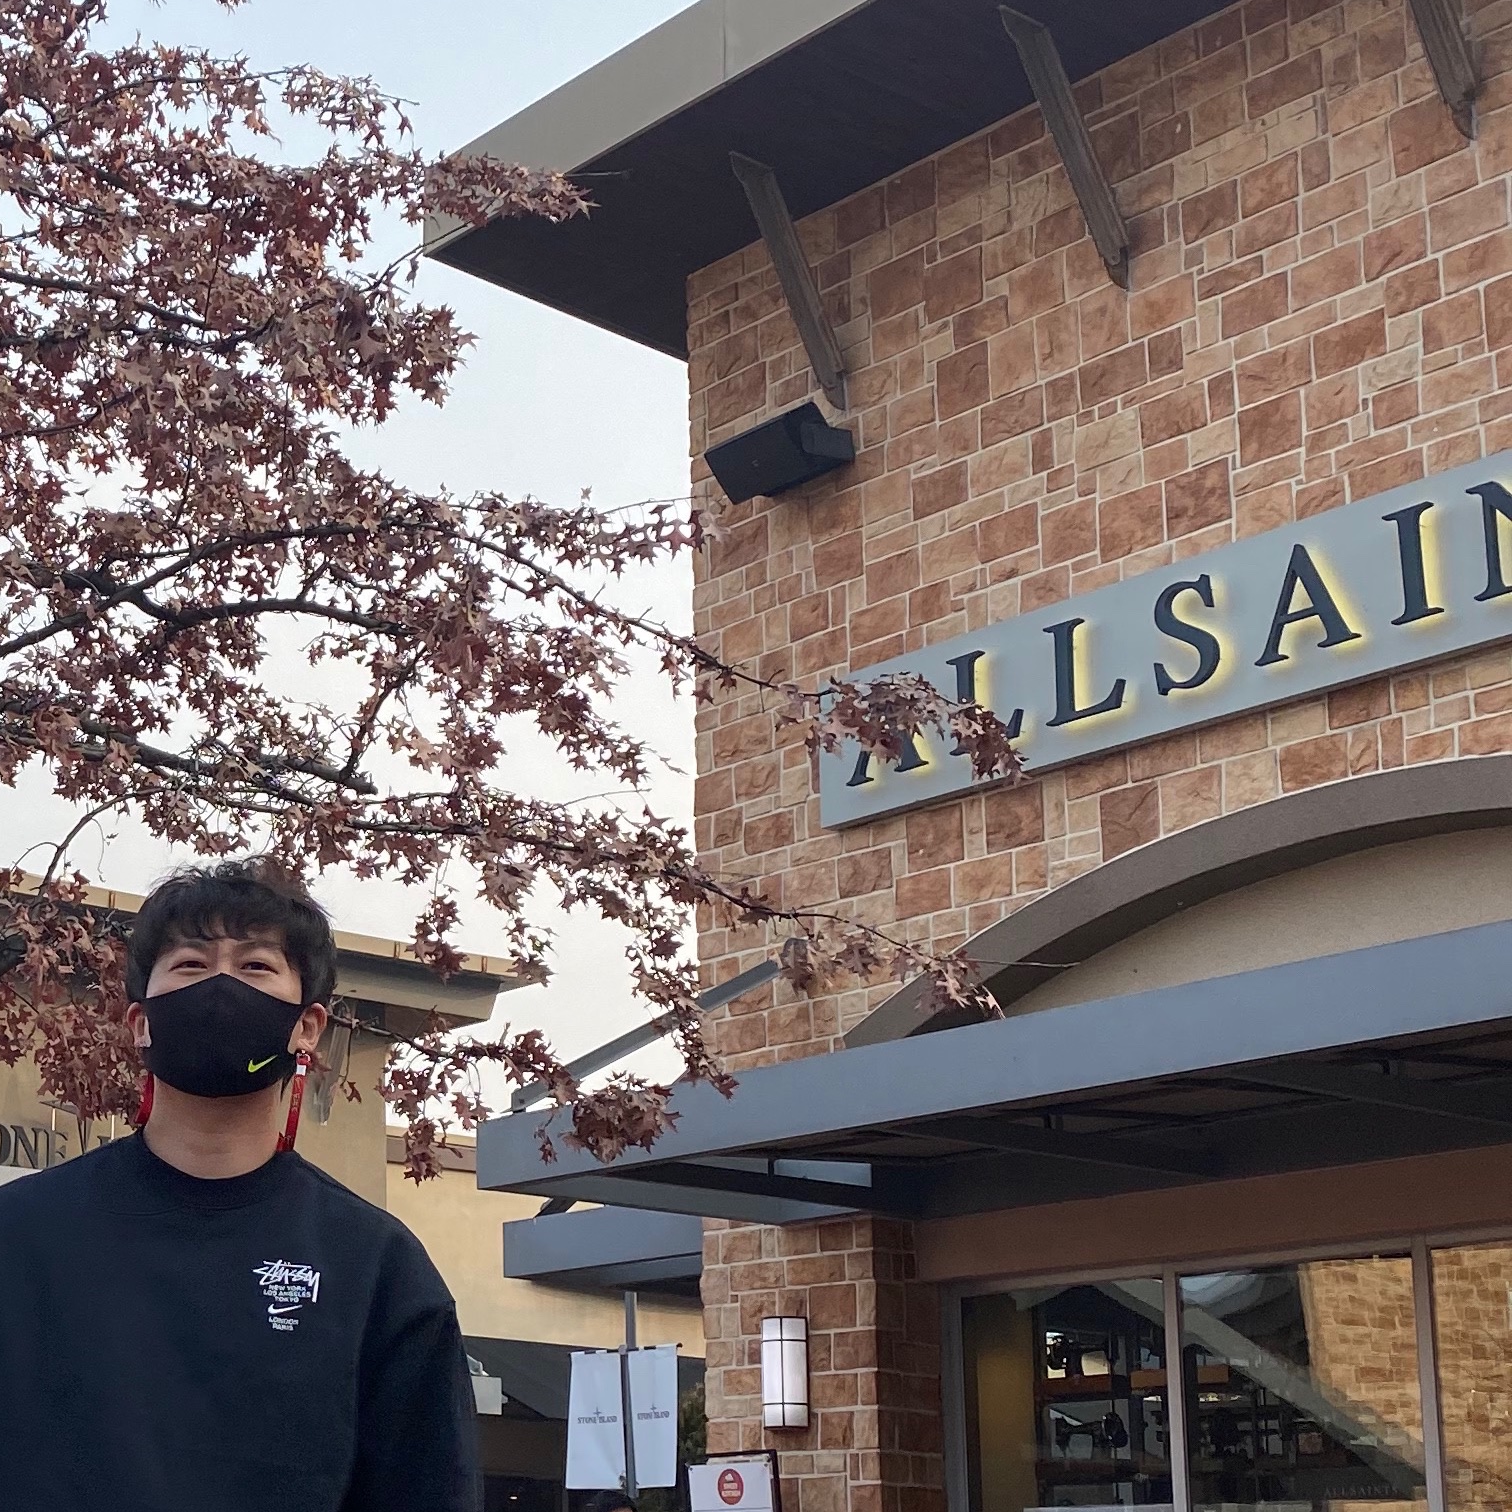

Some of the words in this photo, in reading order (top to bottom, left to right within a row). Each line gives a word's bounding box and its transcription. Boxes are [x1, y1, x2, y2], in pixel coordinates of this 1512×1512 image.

[263, 1289, 278, 1297] LOS
[269, 1317, 299, 1325] LONDON
[577, 1416, 597, 1425] STONE
[598, 1415, 618, 1424] ISLAND
